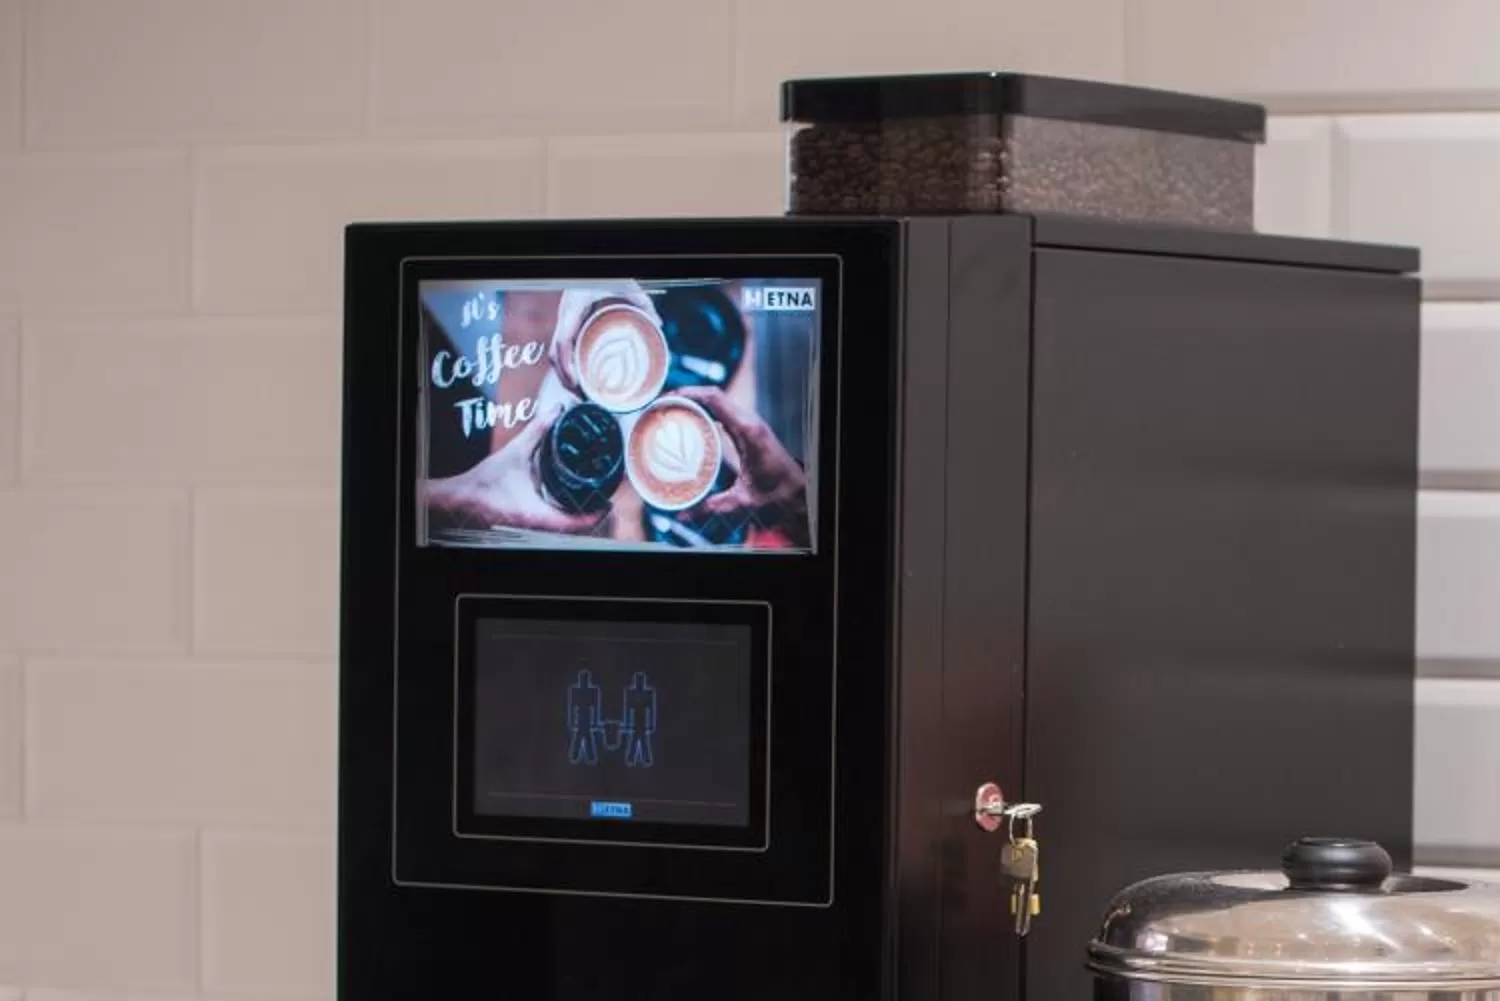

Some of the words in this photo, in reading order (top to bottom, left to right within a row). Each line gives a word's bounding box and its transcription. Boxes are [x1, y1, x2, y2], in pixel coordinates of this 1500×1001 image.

[767, 291, 813, 307] ETNA
[431, 333, 545, 389] Coffee
[453, 397, 536, 438] Time
